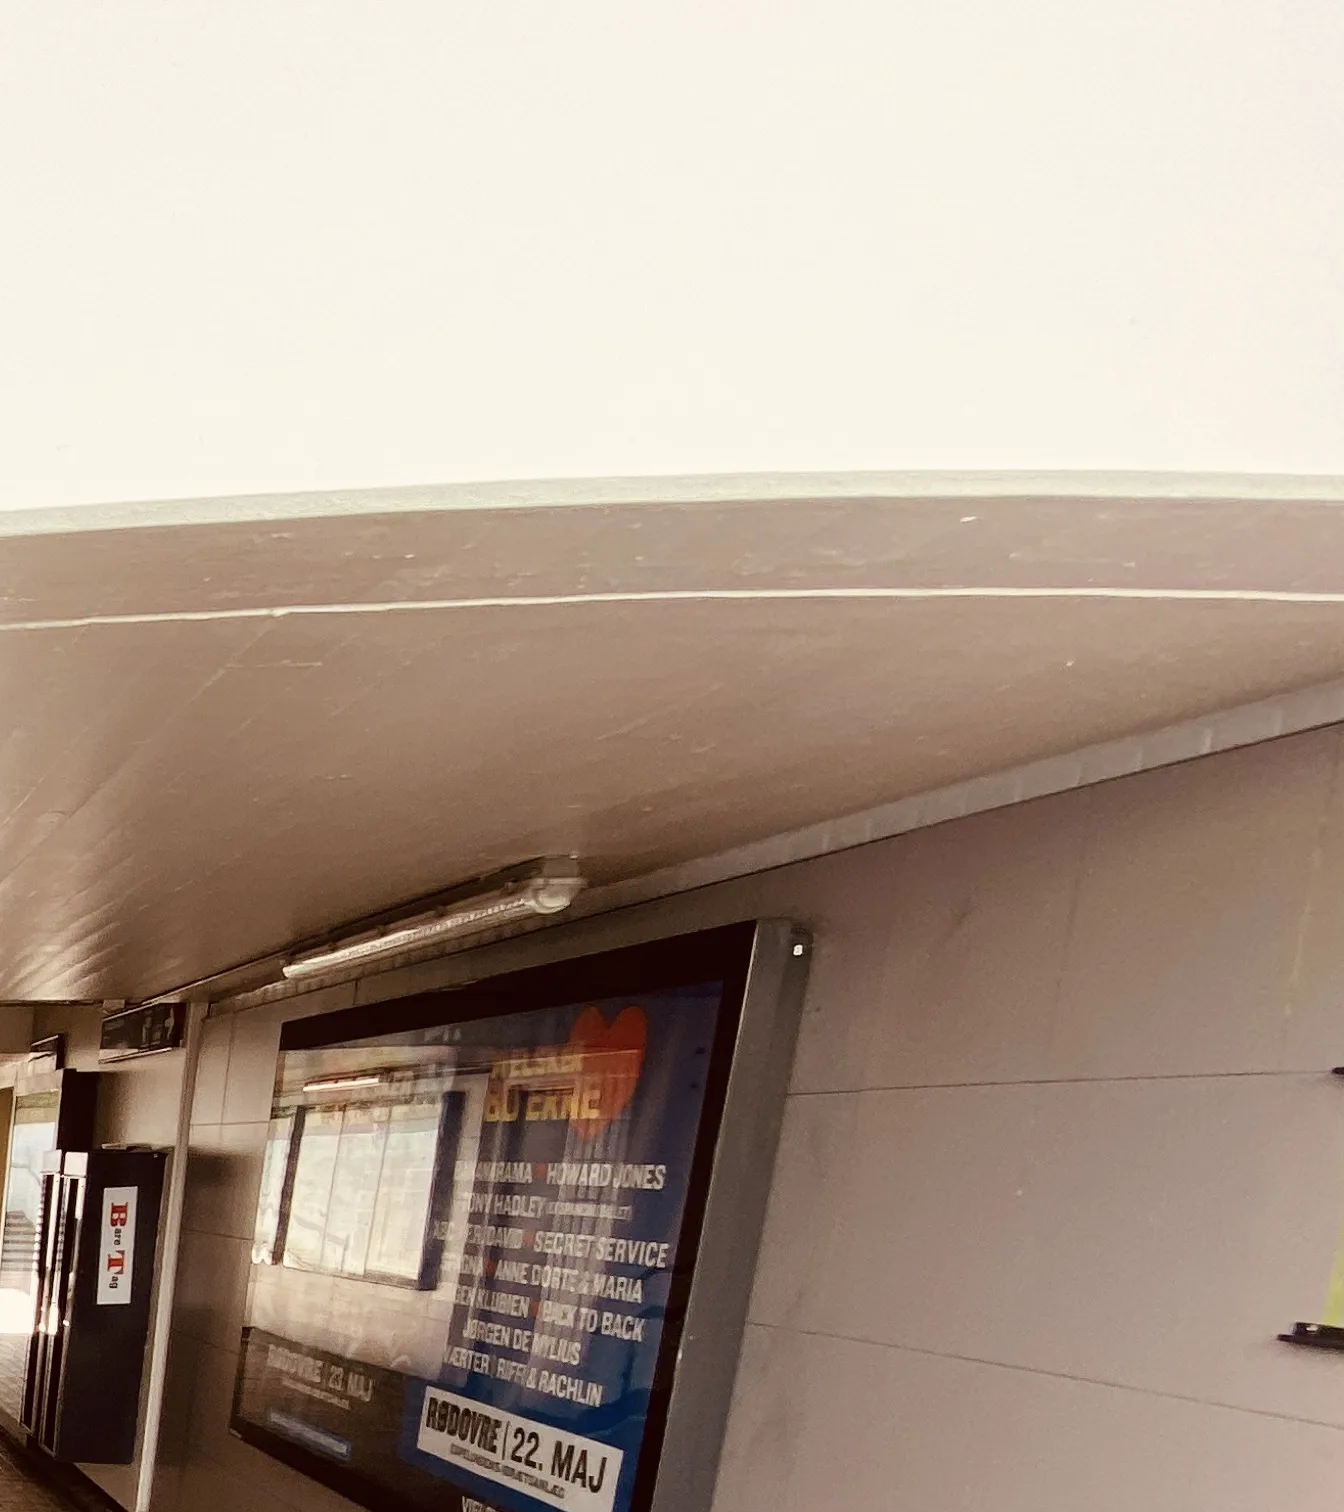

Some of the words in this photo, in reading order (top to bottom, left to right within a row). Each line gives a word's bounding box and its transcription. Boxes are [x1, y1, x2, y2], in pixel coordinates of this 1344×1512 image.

[546, 1162, 610, 1186] HOWARD
[613, 1164, 666, 1189] JONES
[110, 1202, 128, 1245] Bare
[494, 1195, 547, 1218] HADLEY
[534, 1231, 593, 1258] SECRET
[596, 1237, 671, 1268] SERVICE
[107, 1250, 125, 1288] Tag
[494, 1260, 529, 1285] ANNE
[592, 1273, 643, 1303] MARIA
[579, 1307, 598, 1333] TO
[601, 1312, 645, 1342] BACK
[513, 1329, 532, 1351] DE
[532, 1333, 582, 1366] MYLIUS
[538, 1370, 603, 1408] RACHLIN
[425, 1396, 502, 1454] RØDOVRE
[511, 1427, 543, 1472] 22.
[551, 1440, 608, 1494] MAJ
